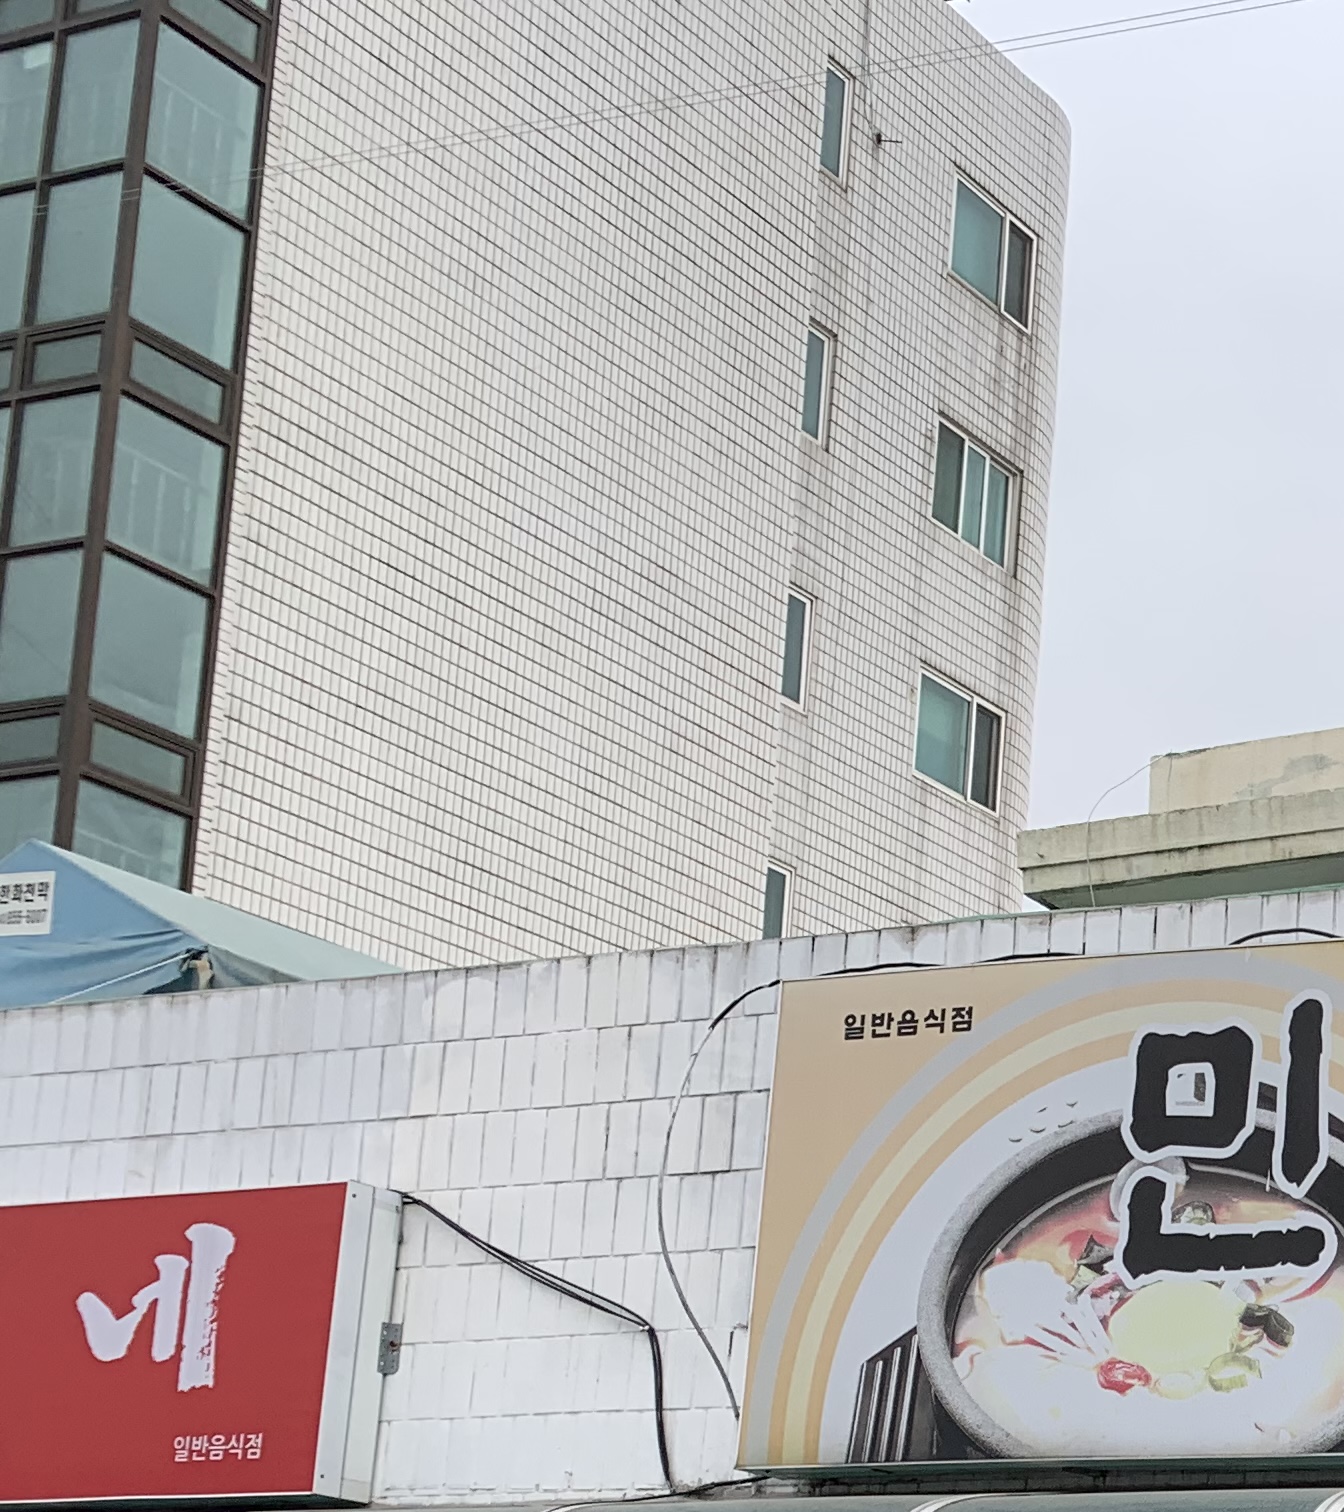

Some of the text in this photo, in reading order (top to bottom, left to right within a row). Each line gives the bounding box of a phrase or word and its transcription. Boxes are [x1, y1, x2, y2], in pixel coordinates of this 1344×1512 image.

[844, 1006, 973, 1040] 일반음식점
[76, 1222, 236, 1391] 네
[173, 1432, 262, 1460] 일반음식점
